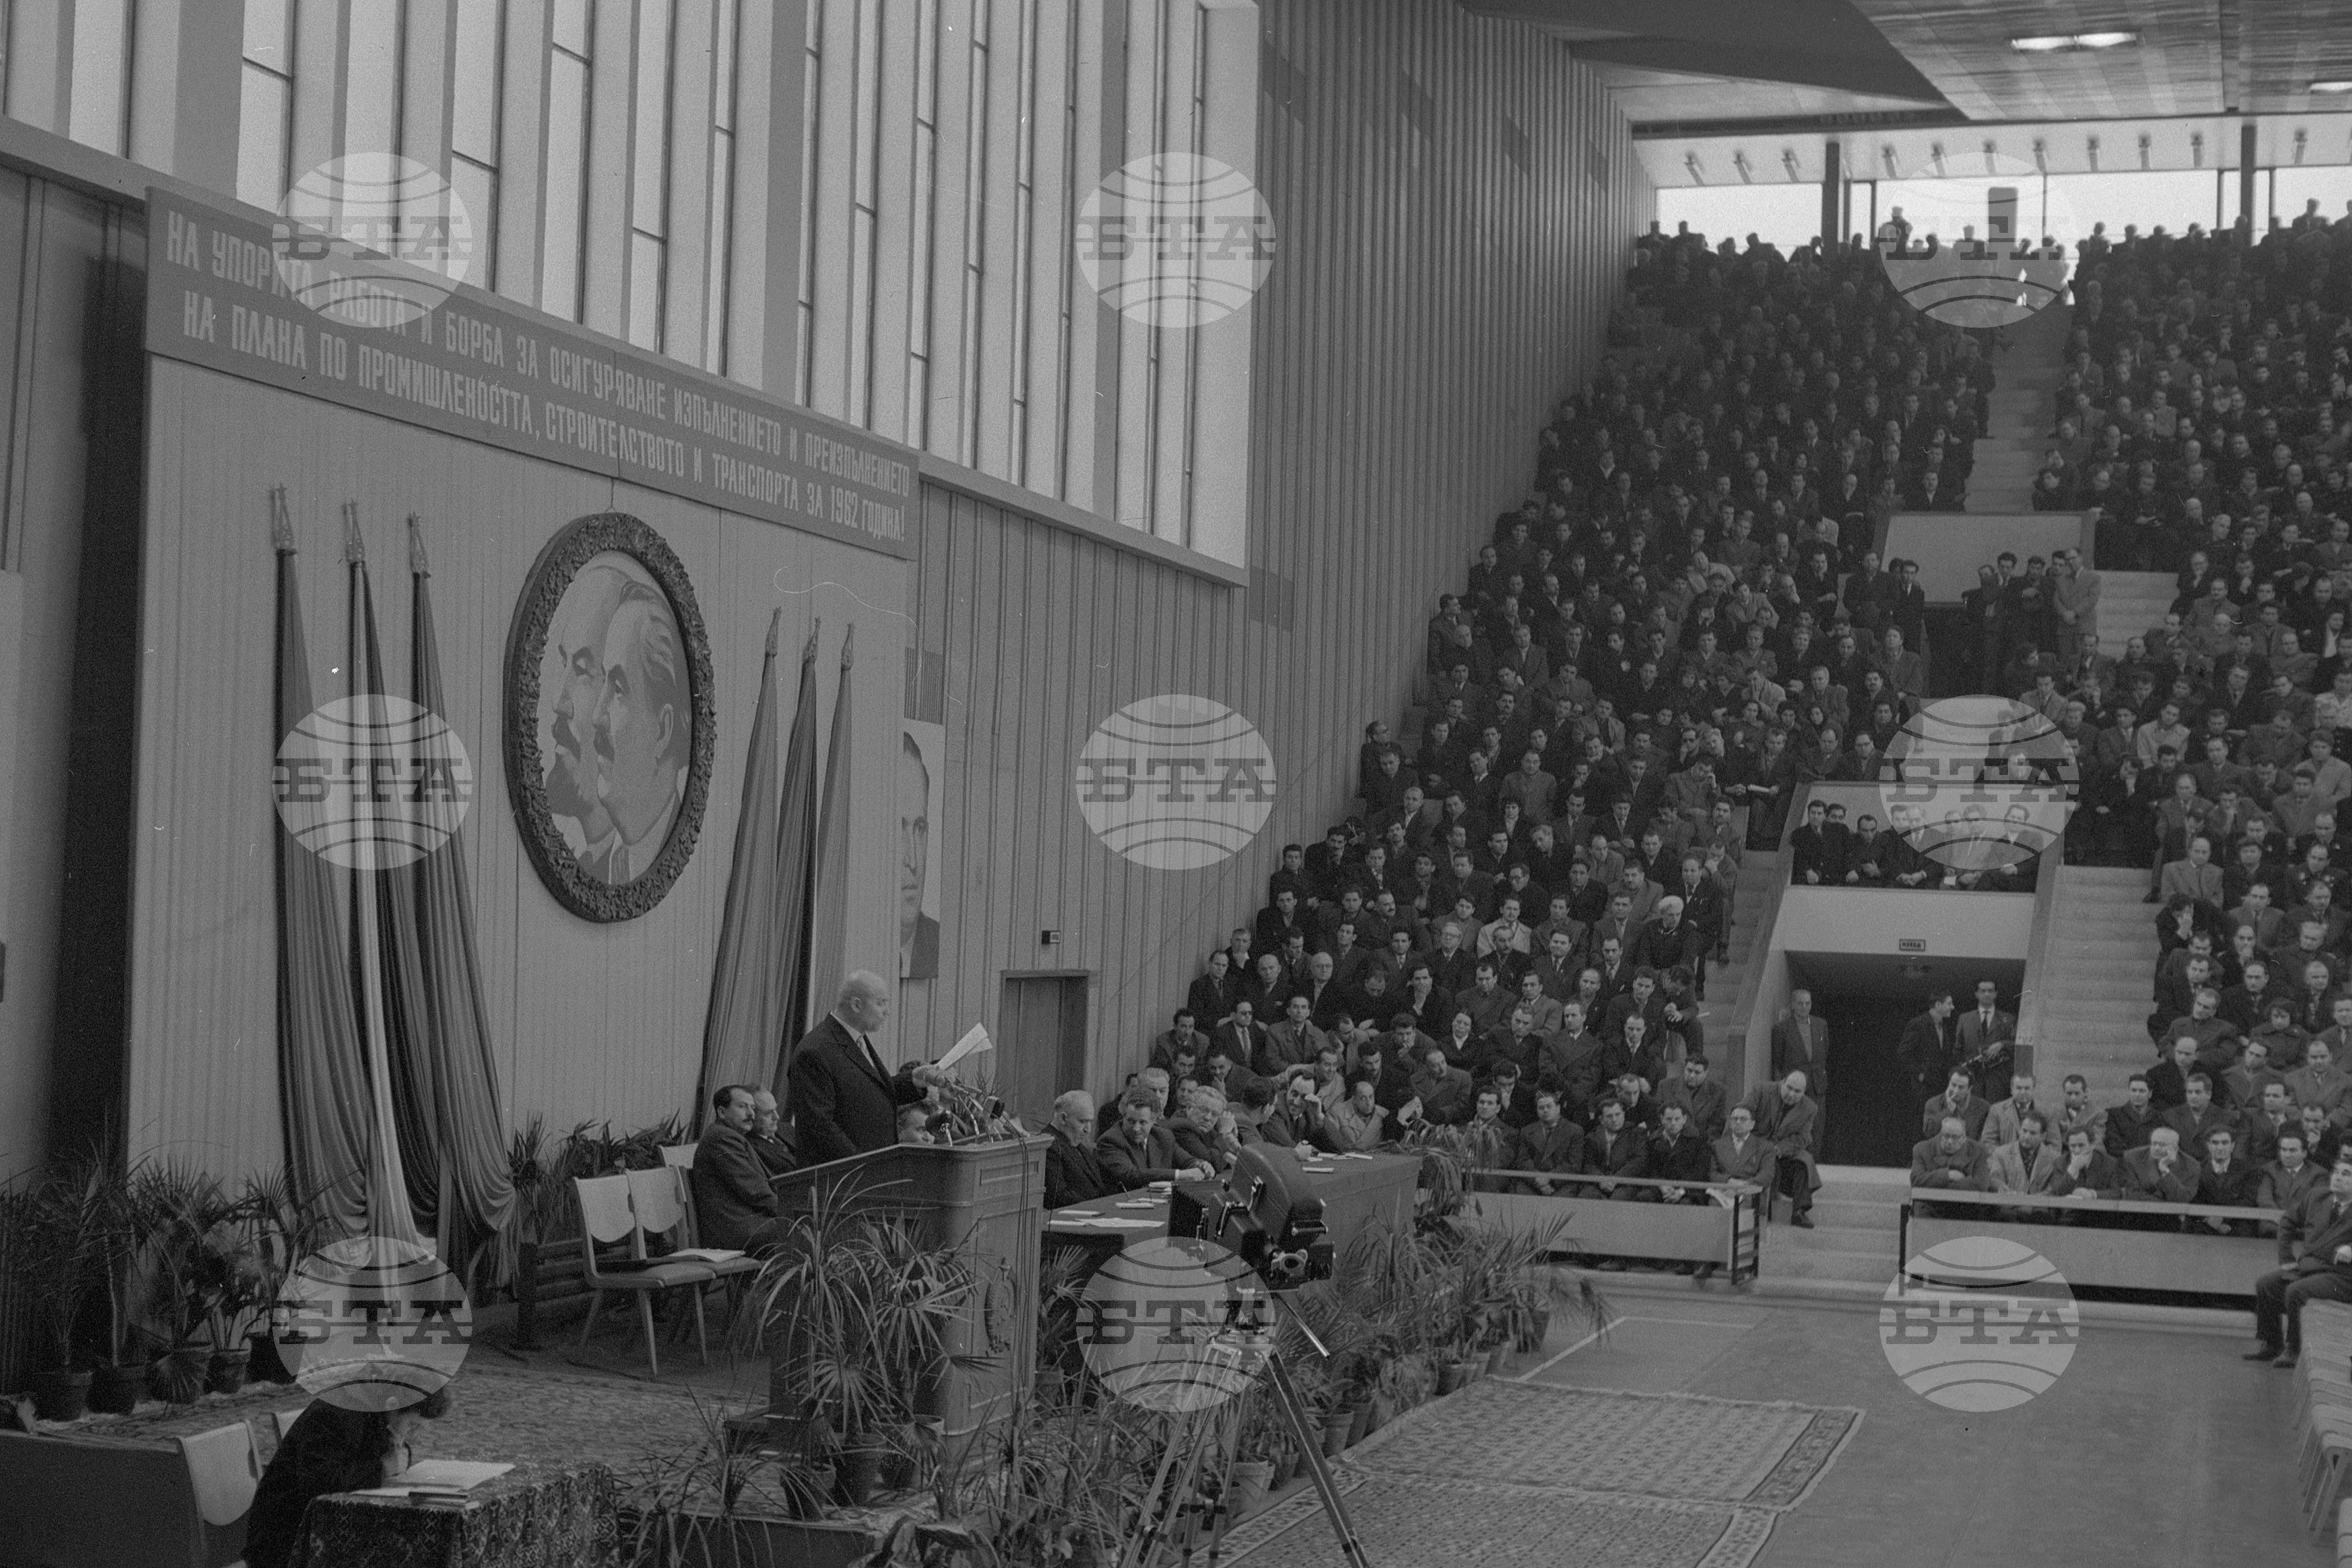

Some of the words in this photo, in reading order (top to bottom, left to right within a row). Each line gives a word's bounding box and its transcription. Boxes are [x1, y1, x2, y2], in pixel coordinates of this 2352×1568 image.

[167, 210, 199, 271] НА
[329, 270, 407, 336] РАБОТА
[421, 303, 432, 345] И
[446, 310, 504, 367] БОРБА
[517, 335, 539, 380] ЗА
[550, 345, 665, 420] ОСИГУРЯВАНЕ
[674, 388, 781, 456] ИЗПЪЛНЕНИЕТО
[790, 427, 797, 462] И
[806, 433, 909, 497] ПРЕИЗПЪЛНЕНИЕТО
[183, 290, 215, 343] НА
[232, 304, 306, 370] ПЛАНА
[320, 332, 347, 380] ПО
[359, 344, 540, 440] ПРОМИШЛЕНОСТТА,
[546, 402, 684, 477] СТРОИТЕЛСТВОТО
[693, 446, 702, 482] И
[712, 453, 799, 512] ТРАНСПОРТА
[807, 482, 823, 518] ЗА
[831, 486, 858, 528] 1962
[861, 499, 904, 542] ГОДИНА!
